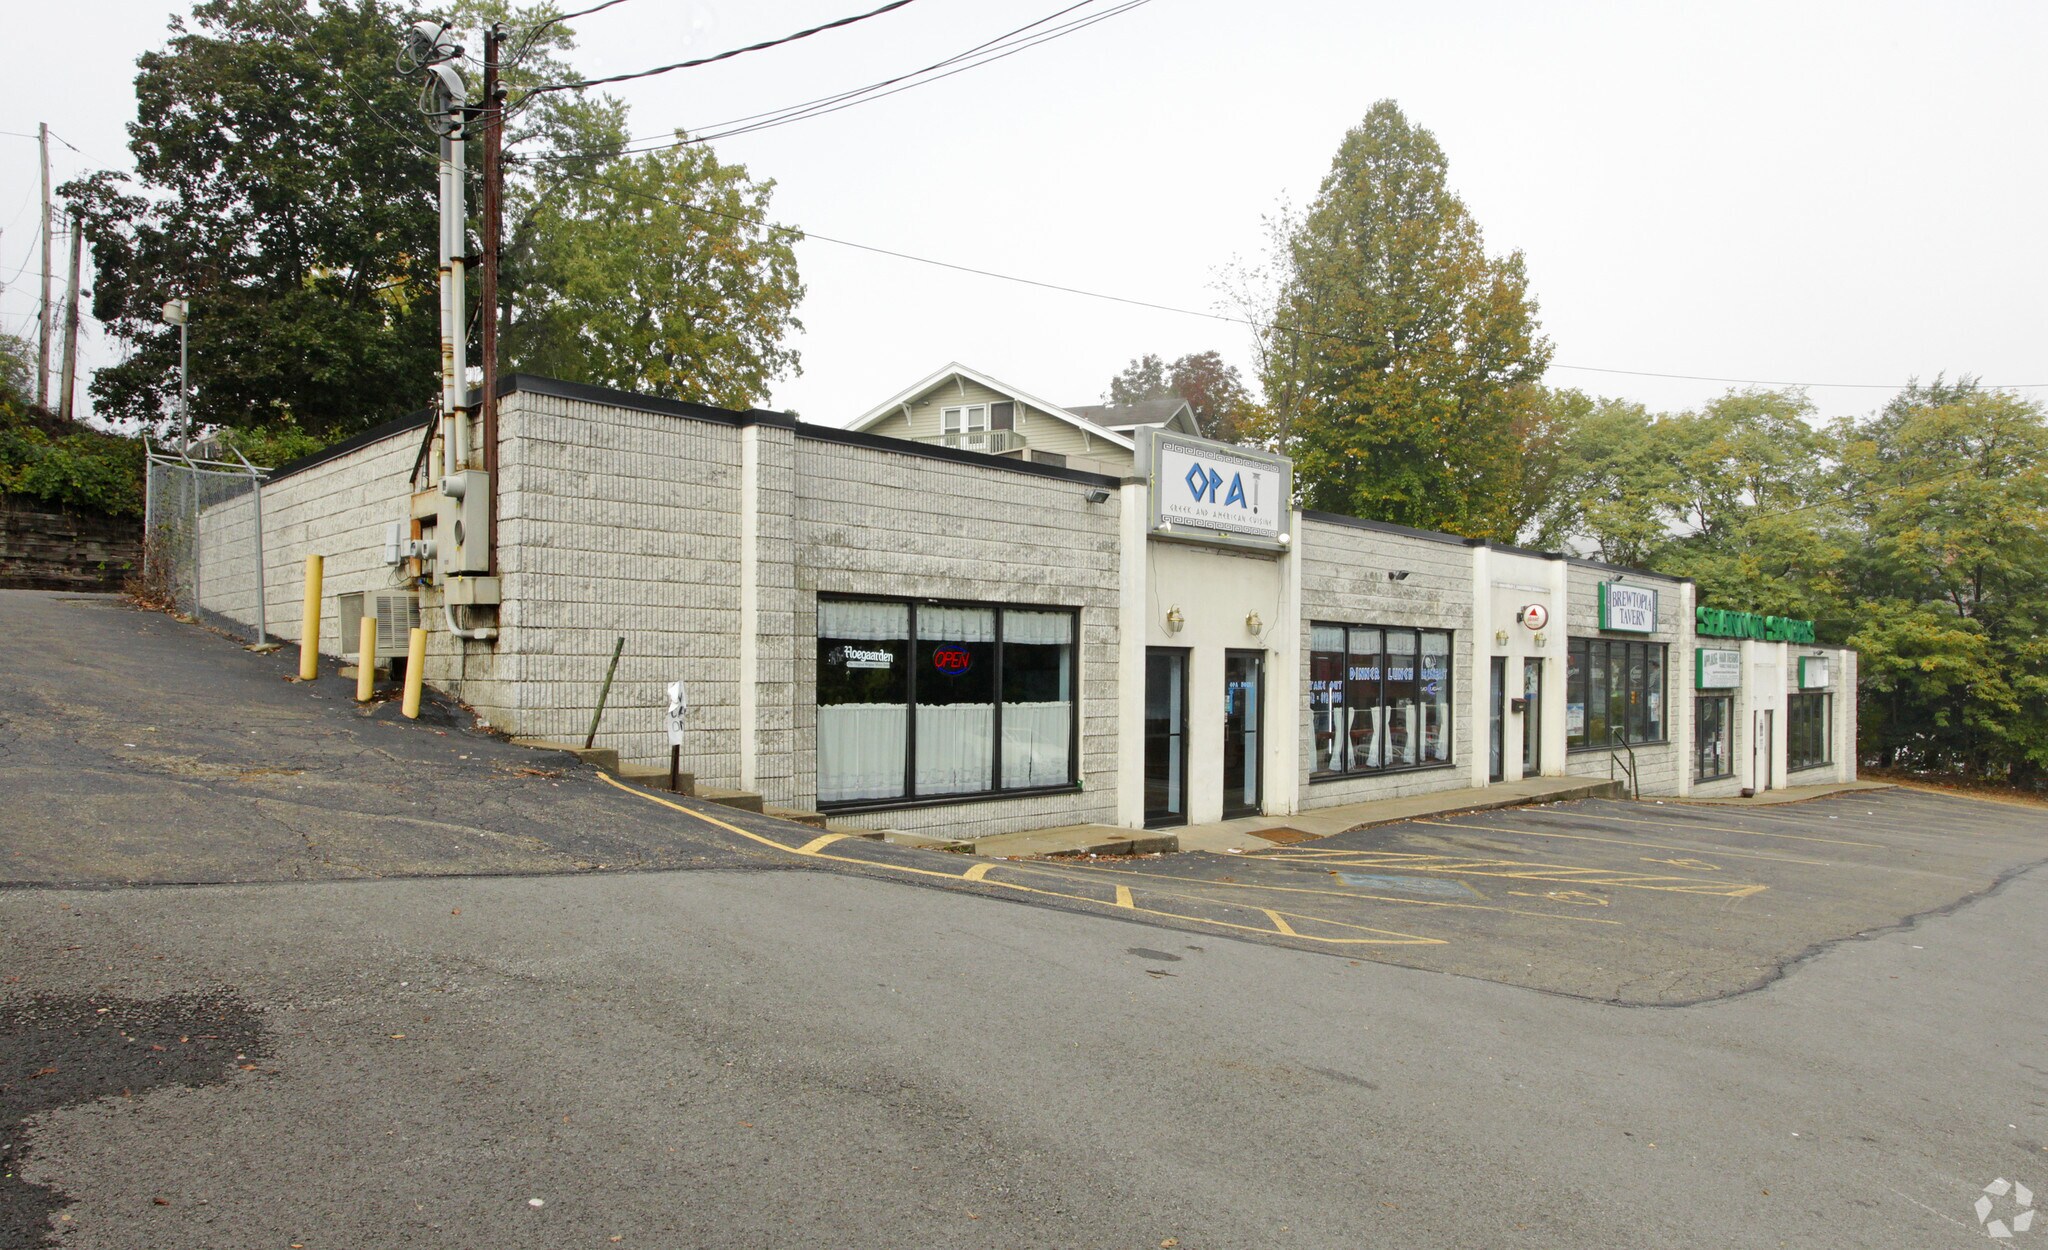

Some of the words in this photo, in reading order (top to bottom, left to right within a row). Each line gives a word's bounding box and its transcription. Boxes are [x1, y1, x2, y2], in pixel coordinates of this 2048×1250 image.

[1170, 504, 1191, 514] GREEK
[1213, 512, 1246, 523] AMERICAN
[1250, 517, 1272, 526] CUISINE
[1612, 591, 1652, 612] BREWTOPIA
[1620, 608, 1645, 625] TAVERN
[844, 645, 893, 662] Hoegaarden
[934, 651, 970, 668] OPEN
[1349, 667, 1380, 680] DINNER
[1388, 667, 1413, 680] LUNCH
